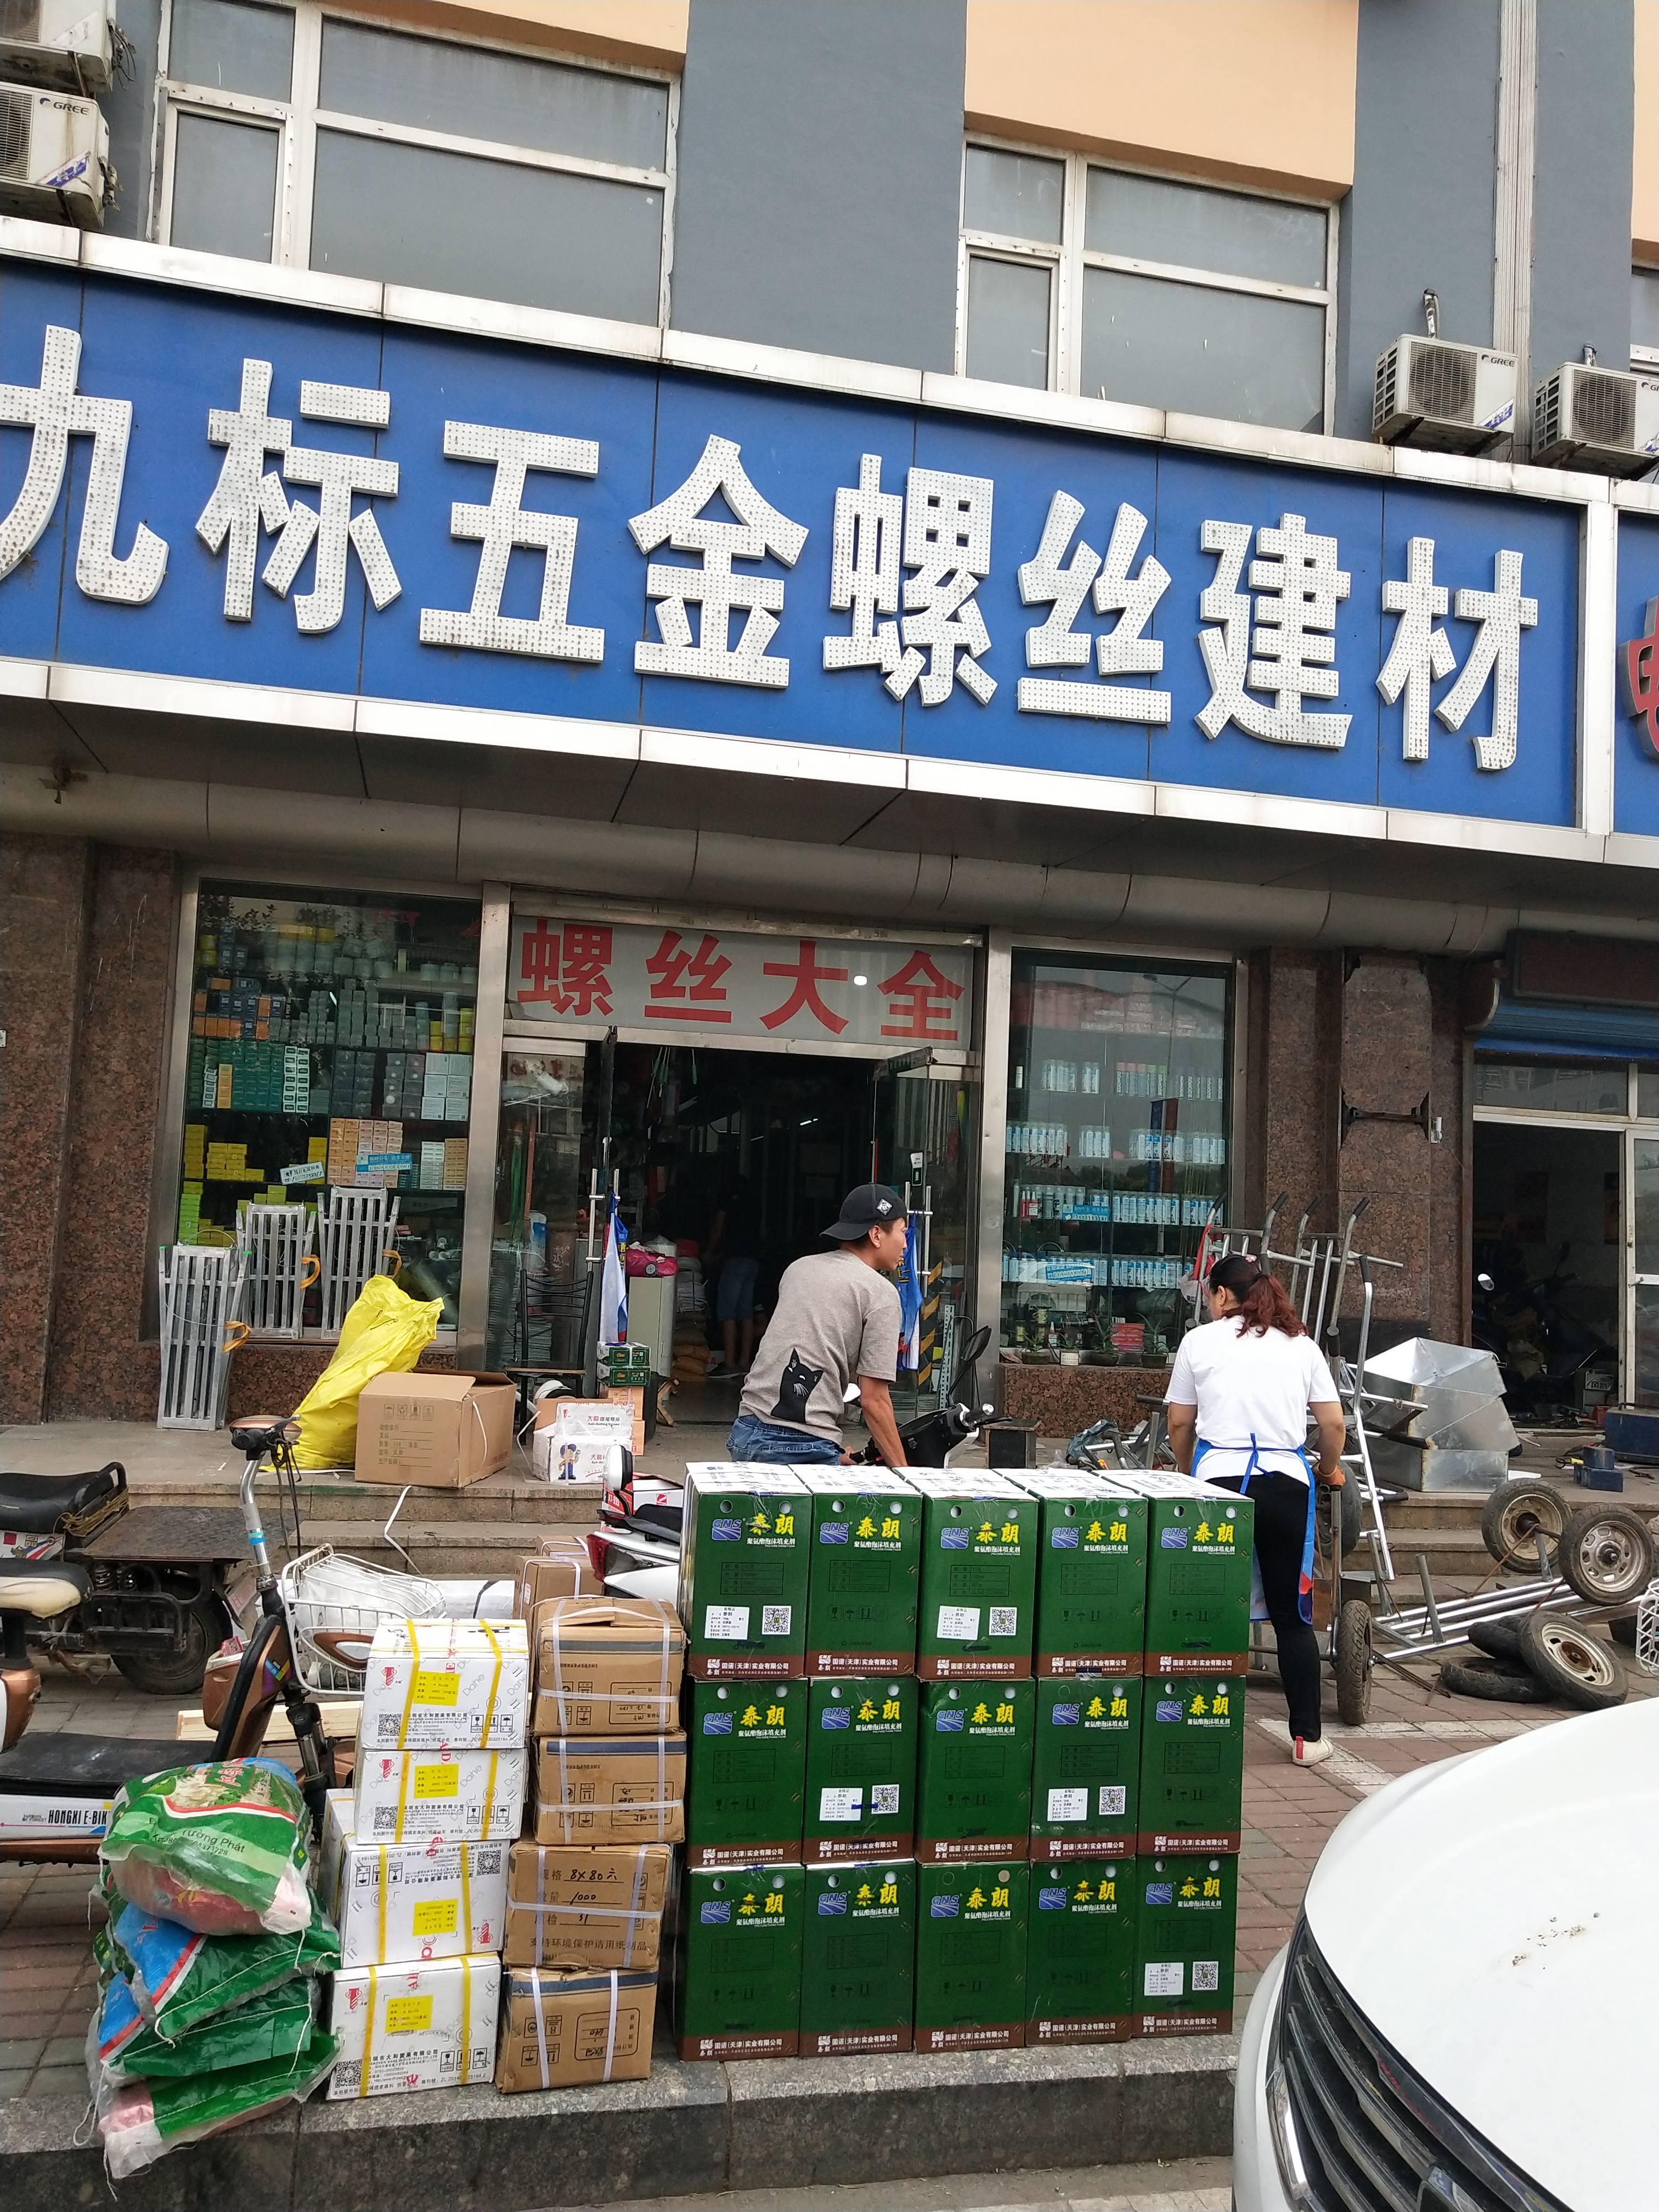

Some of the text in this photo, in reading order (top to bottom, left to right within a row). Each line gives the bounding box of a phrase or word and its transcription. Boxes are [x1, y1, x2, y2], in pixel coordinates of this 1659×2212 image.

[53, 101, 90, 116] GREE
[1491, 356, 1515, 368] GREE
[0, 324, 1538, 770] 九标五金螺丝建材
[517, 918, 965, 1041] 螺丝大全
[713, 1519, 742, 1527] GNS
[821, 1522, 848, 1531] GNS
[856, 1516, 900, 1539] 泰朗
[941, 1528, 969, 1536] GNS
[974, 1521, 1020, 1544] 泰朗
[1052, 1527, 1079, 1536] GNS
[1085, 1521, 1127, 1543] 泰朗
[1163, 1527, 1187, 1536] GNS
[1194, 1521, 1234, 1543] 泰朗
[857, 1700, 900, 1722] 泰朗
[1053, 1704, 1080, 1713] GNS
[1086, 1697, 1128, 1719] 泰朗
[1156, 1701, 1182, 1709] GNS
[1189, 1695, 1229, 1716] 泰朗
[704, 1712, 732, 1722] GNS
[741, 1705, 785, 1727] 泰朗
[822, 1707, 850, 1717] GNS
[937, 1709, 964, 1719] GNS
[971, 1703, 1014, 1724] 泰朗
[48, 1809, 110, 1825] HONGXI E-BIK
[219, 1838, 246, 1853] Phát
[405, 1873, 473, 1884] 深市大和實業有限公司
[1040, 1888, 1066, 1897] GNS
[1147, 1883, 1172, 1892] GNS
[569, 1892, 596, 1905] 1000
[819, 1893, 847, 1903] GNS
[932, 1895, 959, 1904] GNS
[967, 1887, 1009, 1909] 泰朗
[702, 1901, 730, 1911] GNS
[535, 1914, 557, 1925] 检
[370, 2049, 438, 2061] 圳市大和實業有限公司
